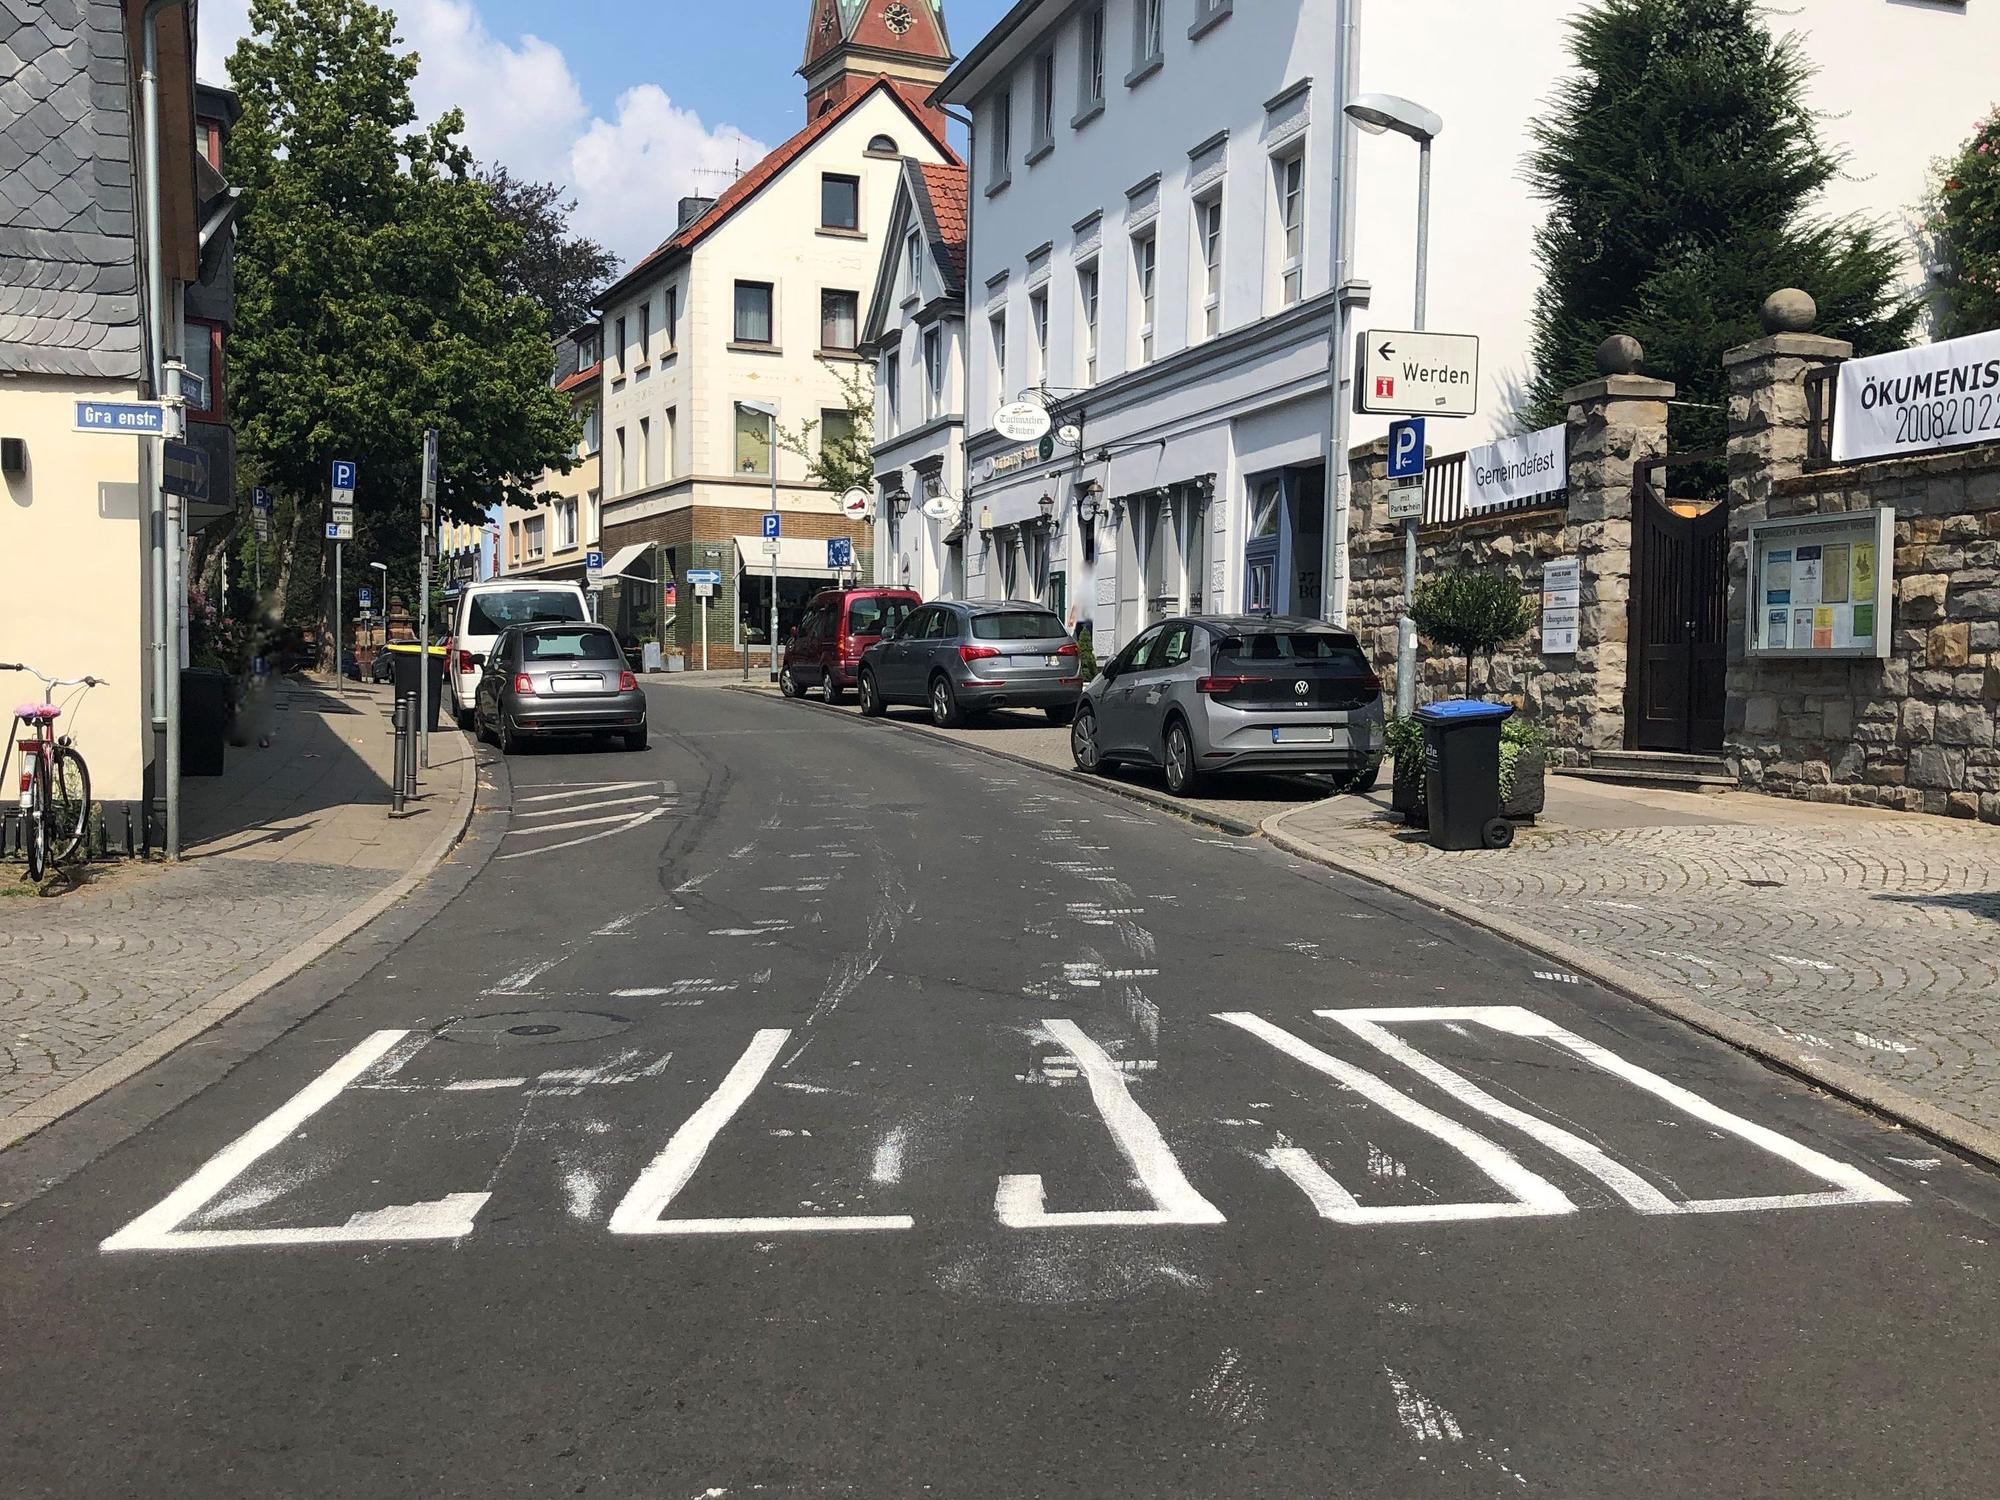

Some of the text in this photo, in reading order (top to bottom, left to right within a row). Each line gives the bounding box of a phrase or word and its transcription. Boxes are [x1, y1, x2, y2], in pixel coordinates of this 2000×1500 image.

[1403, 362, 1469, 385] Werden
[1860, 359, 2000, 410] ÖKUMENIS
[1396, 426, 1416, 470] P
[338, 466, 350, 485] P
[1475, 449, 1555, 487] Gemeindefest
[766, 517, 776, 535] P
